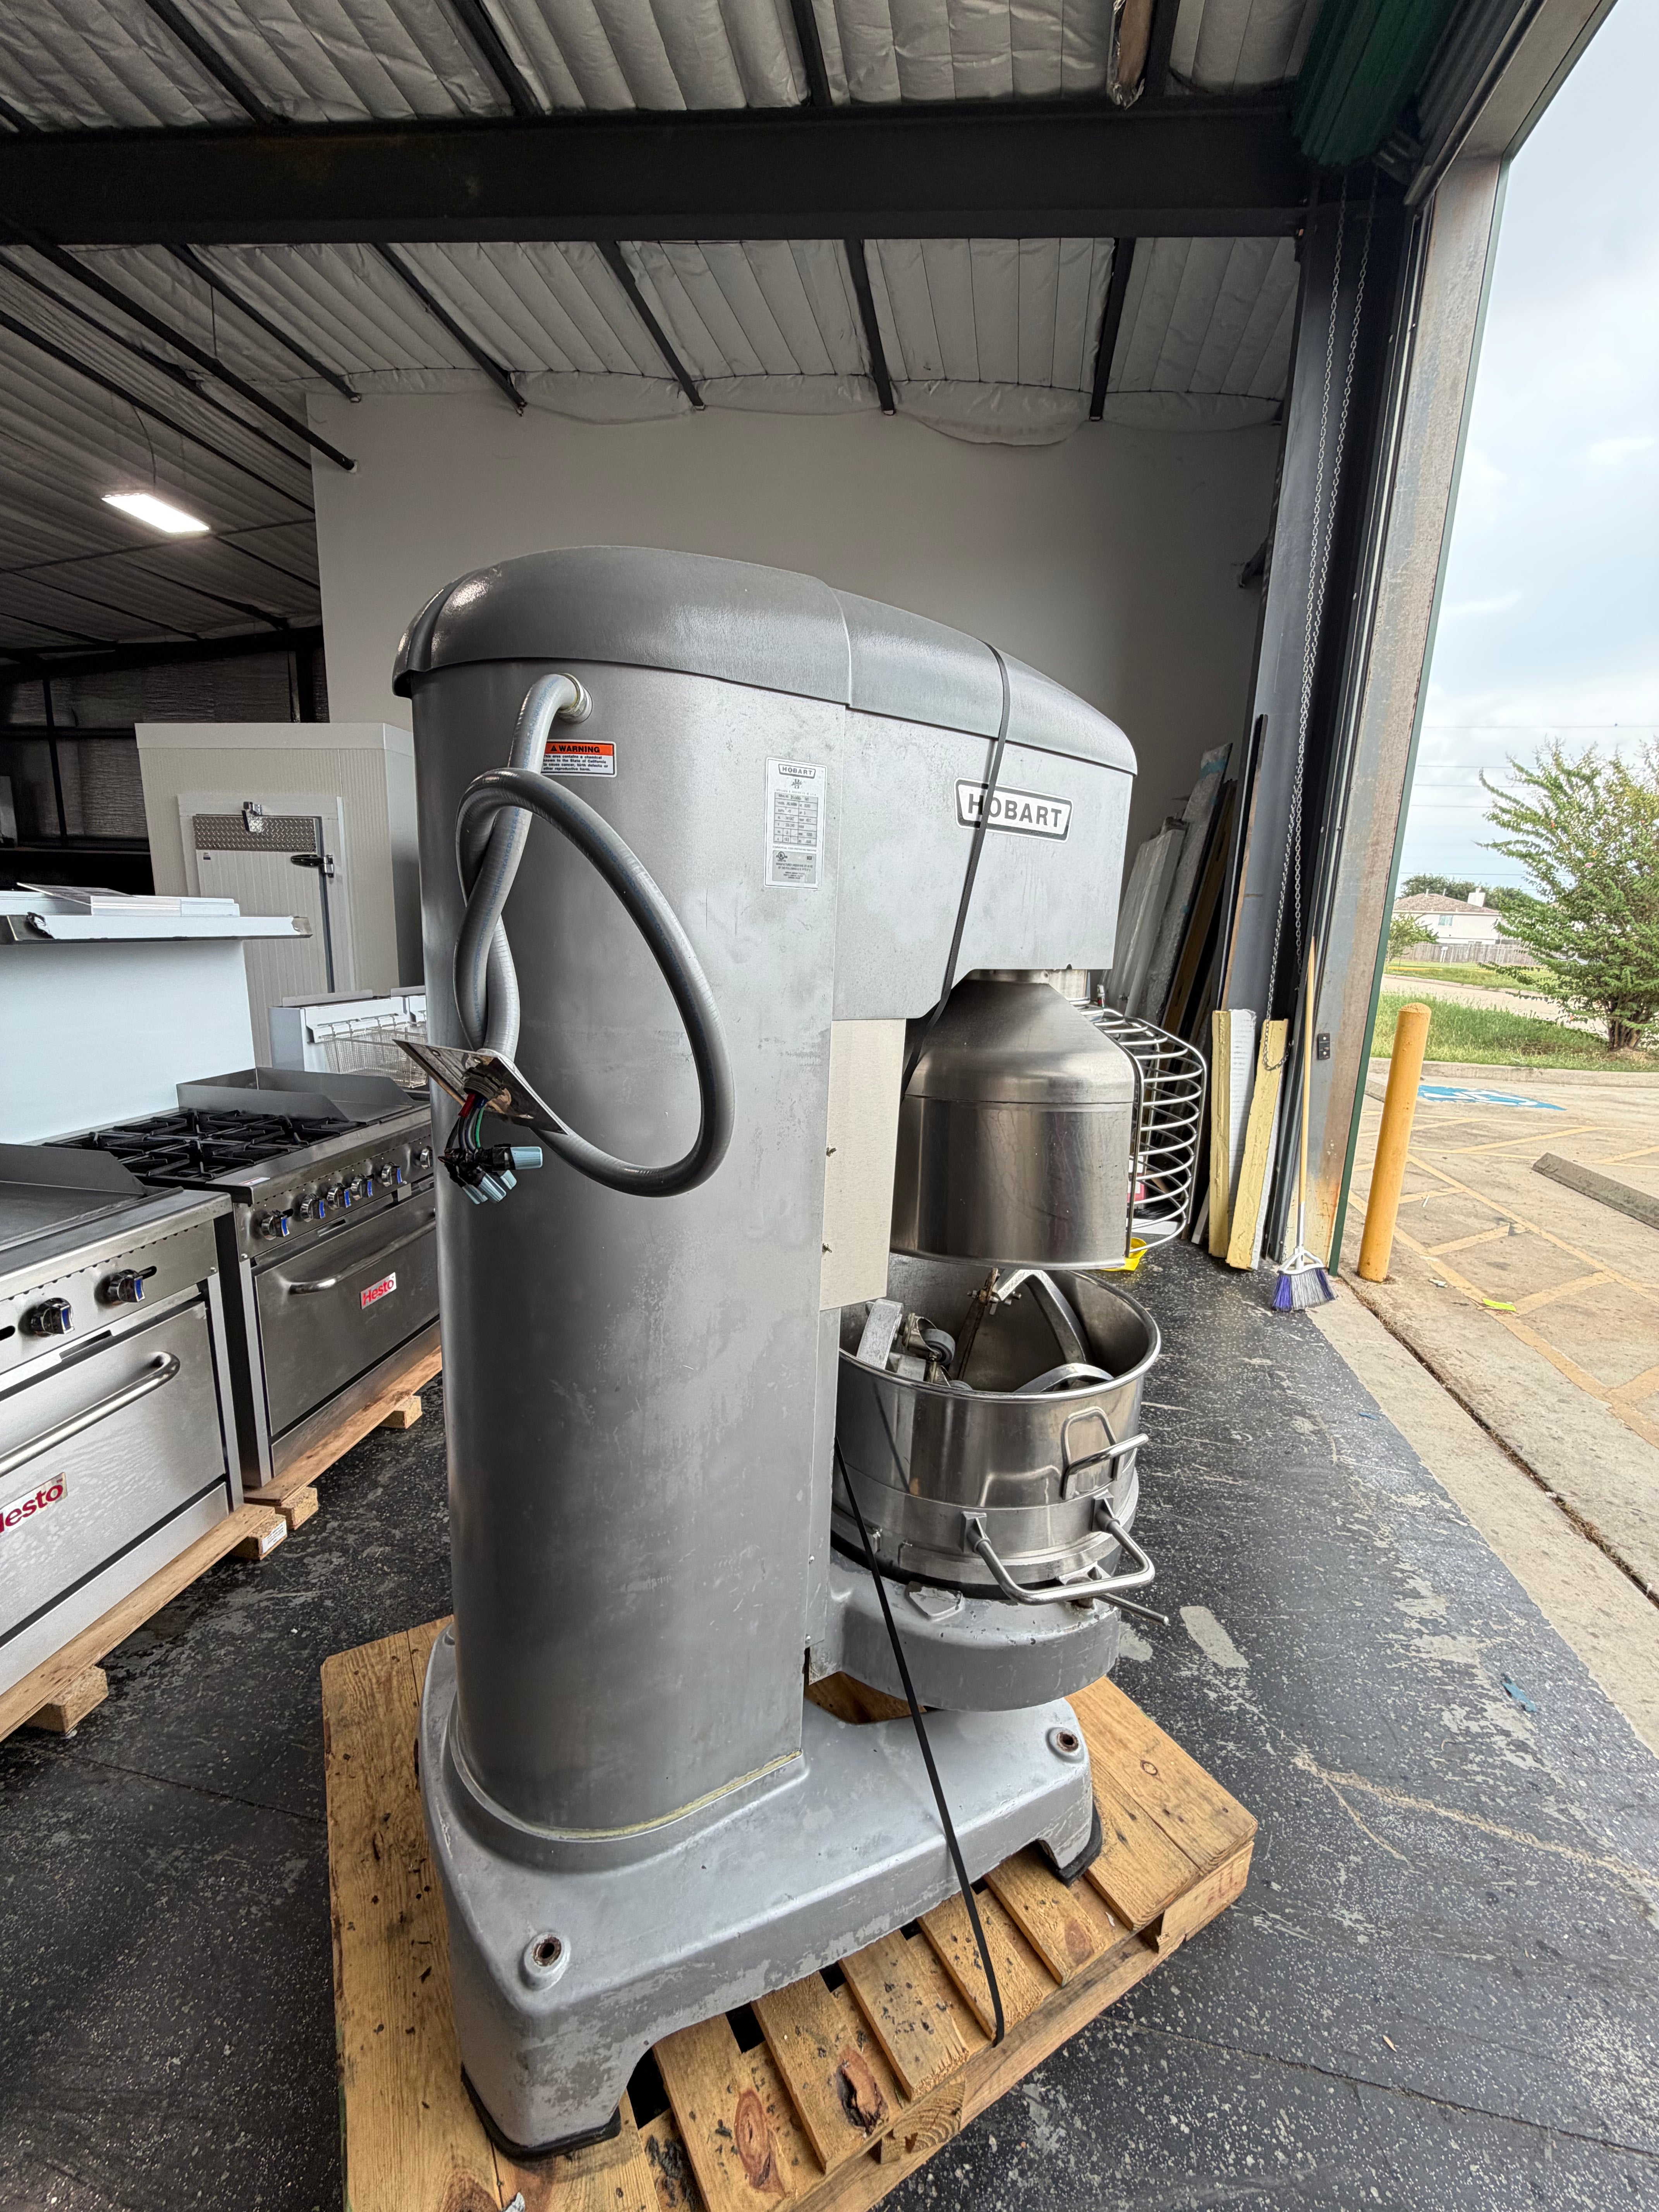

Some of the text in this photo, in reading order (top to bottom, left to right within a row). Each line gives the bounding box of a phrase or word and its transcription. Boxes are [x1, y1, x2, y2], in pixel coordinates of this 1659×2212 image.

[782, 766, 812, 775] HOBART
[968, 793, 1062, 827] HOBART
[363, 1279, 394, 1306] Hesto
